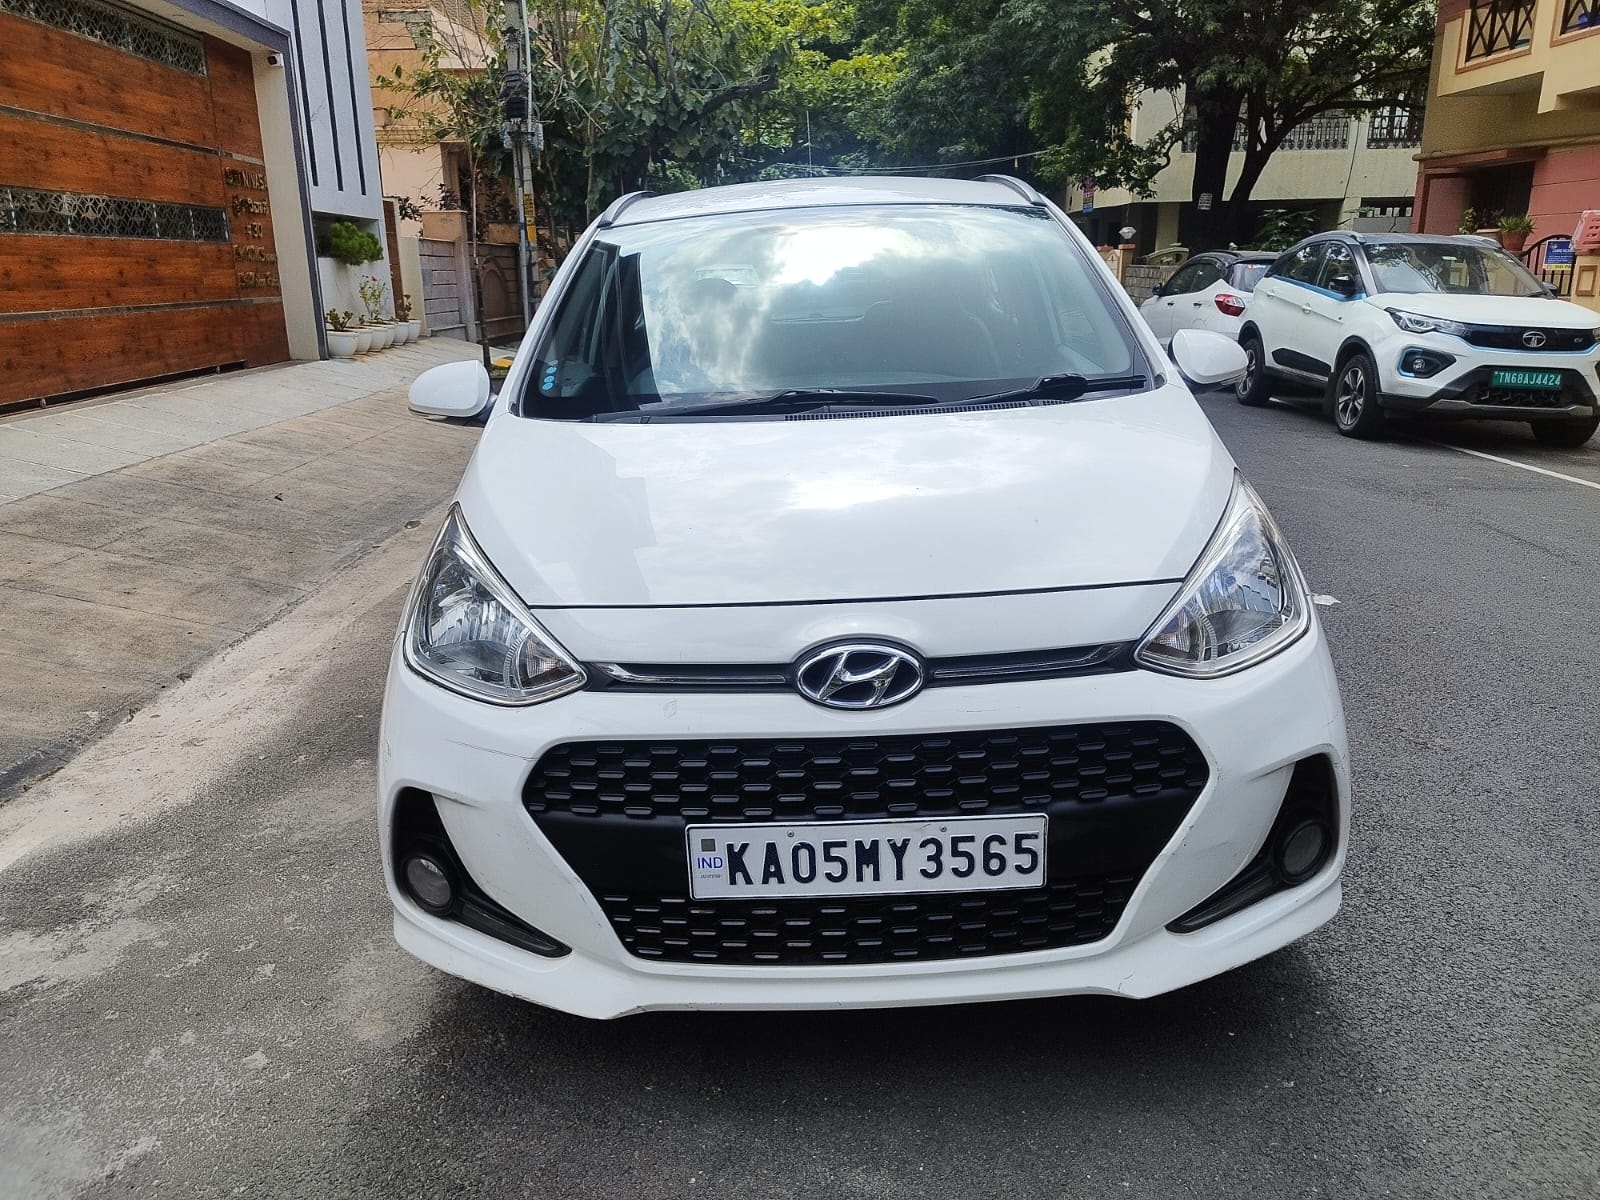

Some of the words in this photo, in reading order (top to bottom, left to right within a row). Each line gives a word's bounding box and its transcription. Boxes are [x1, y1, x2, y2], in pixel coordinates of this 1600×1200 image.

[1499, 372, 1561, 386] TN68AJ4424
[697, 856, 723, 869] IND
[726, 832, 1039, 885] KA05MY3565
